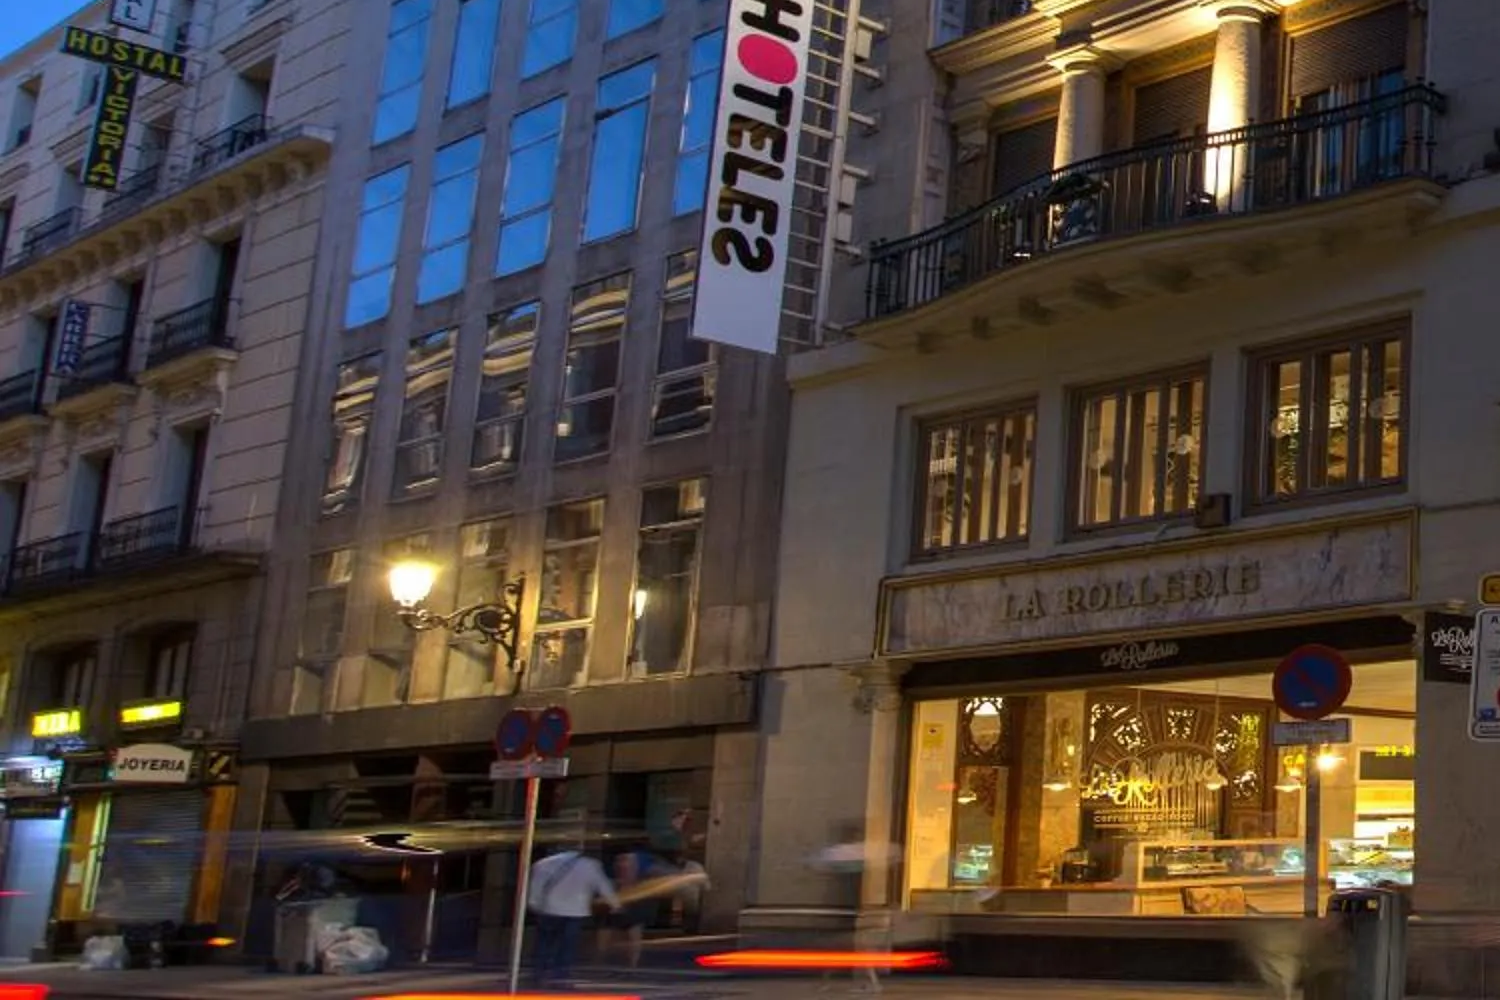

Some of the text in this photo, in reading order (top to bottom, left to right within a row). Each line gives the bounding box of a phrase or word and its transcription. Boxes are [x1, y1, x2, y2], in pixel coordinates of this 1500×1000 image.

[67, 29, 183, 78] HOSTAL
[91, 66, 135, 177] VICTORIA
[1003, 561, 1263, 622] LA ROLLERIE
[118, 756, 186, 773] JOYERIA
